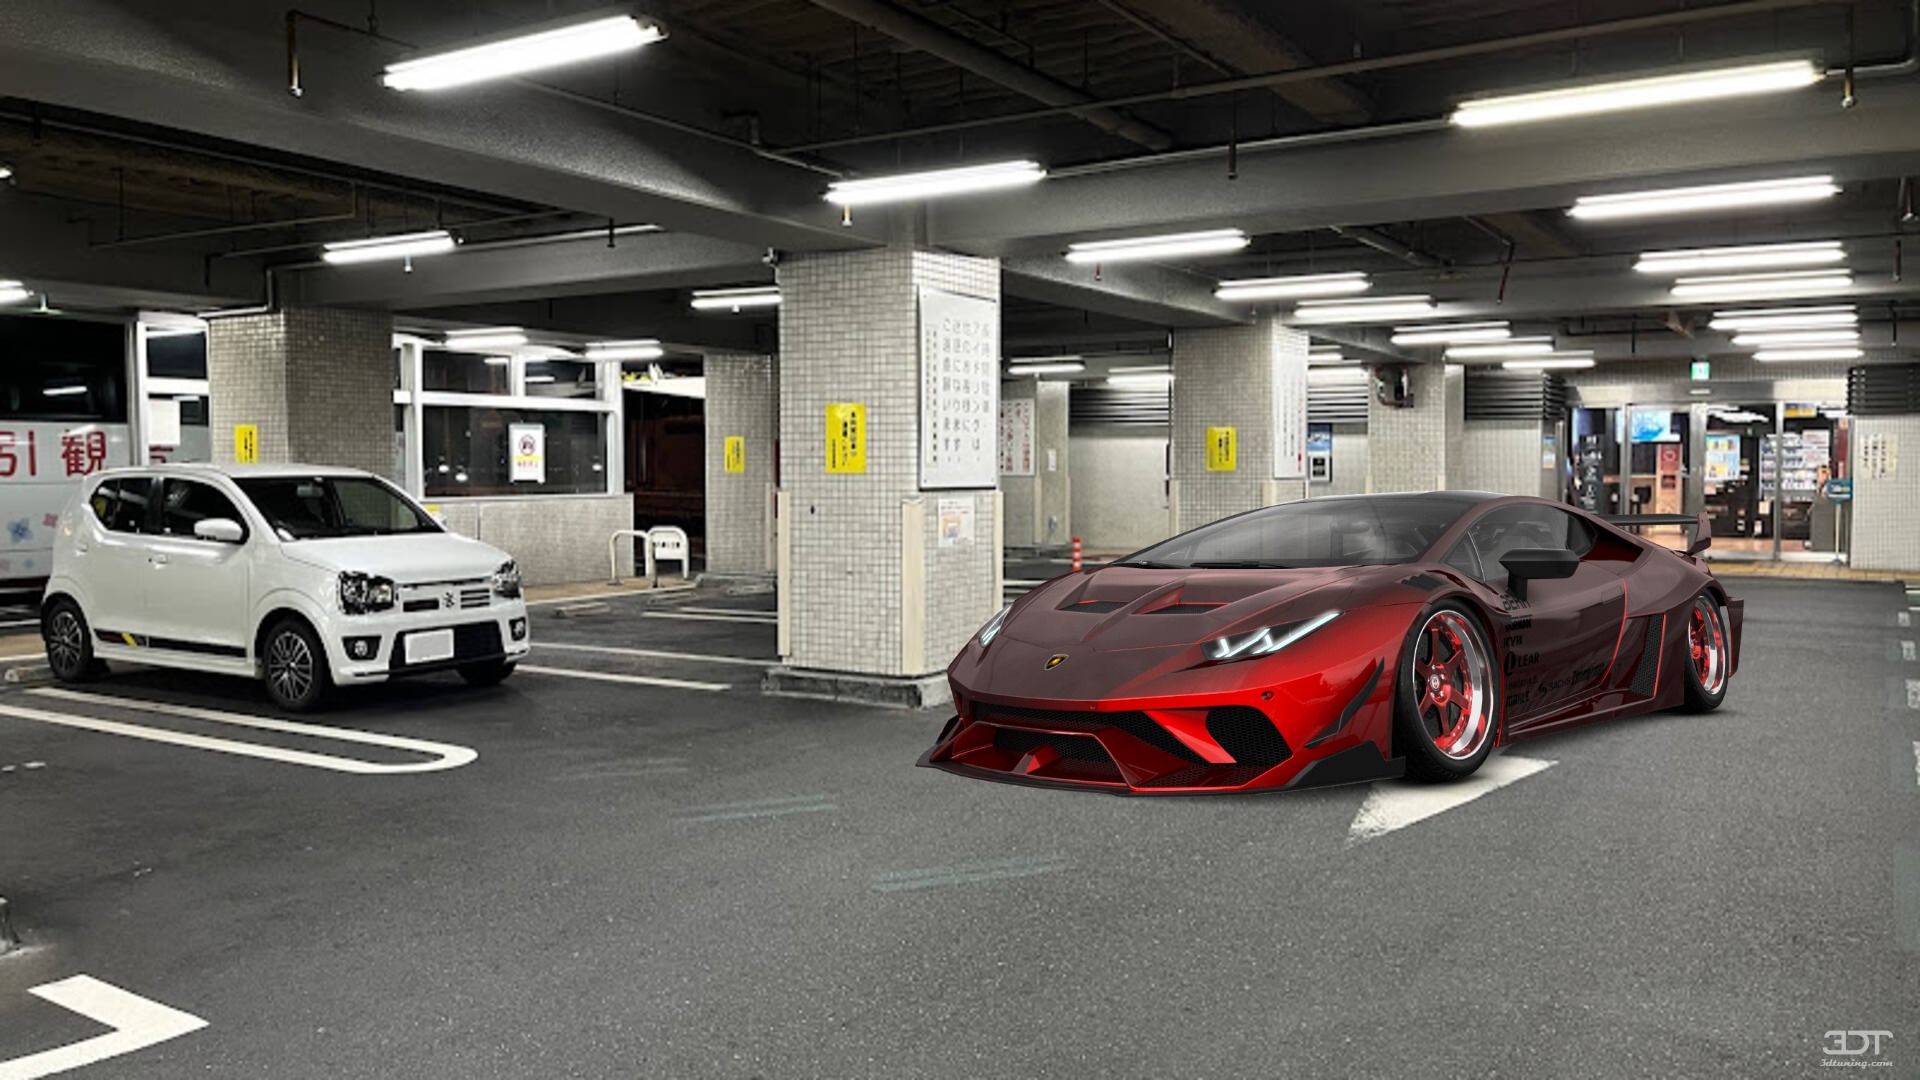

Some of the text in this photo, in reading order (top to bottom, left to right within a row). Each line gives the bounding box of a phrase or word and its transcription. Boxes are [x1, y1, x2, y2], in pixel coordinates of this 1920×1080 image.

[1503, 635, 1523, 649] KYB
[1518, 652, 1540, 667] LEAR
[1548, 677, 1571, 692] SACHS
